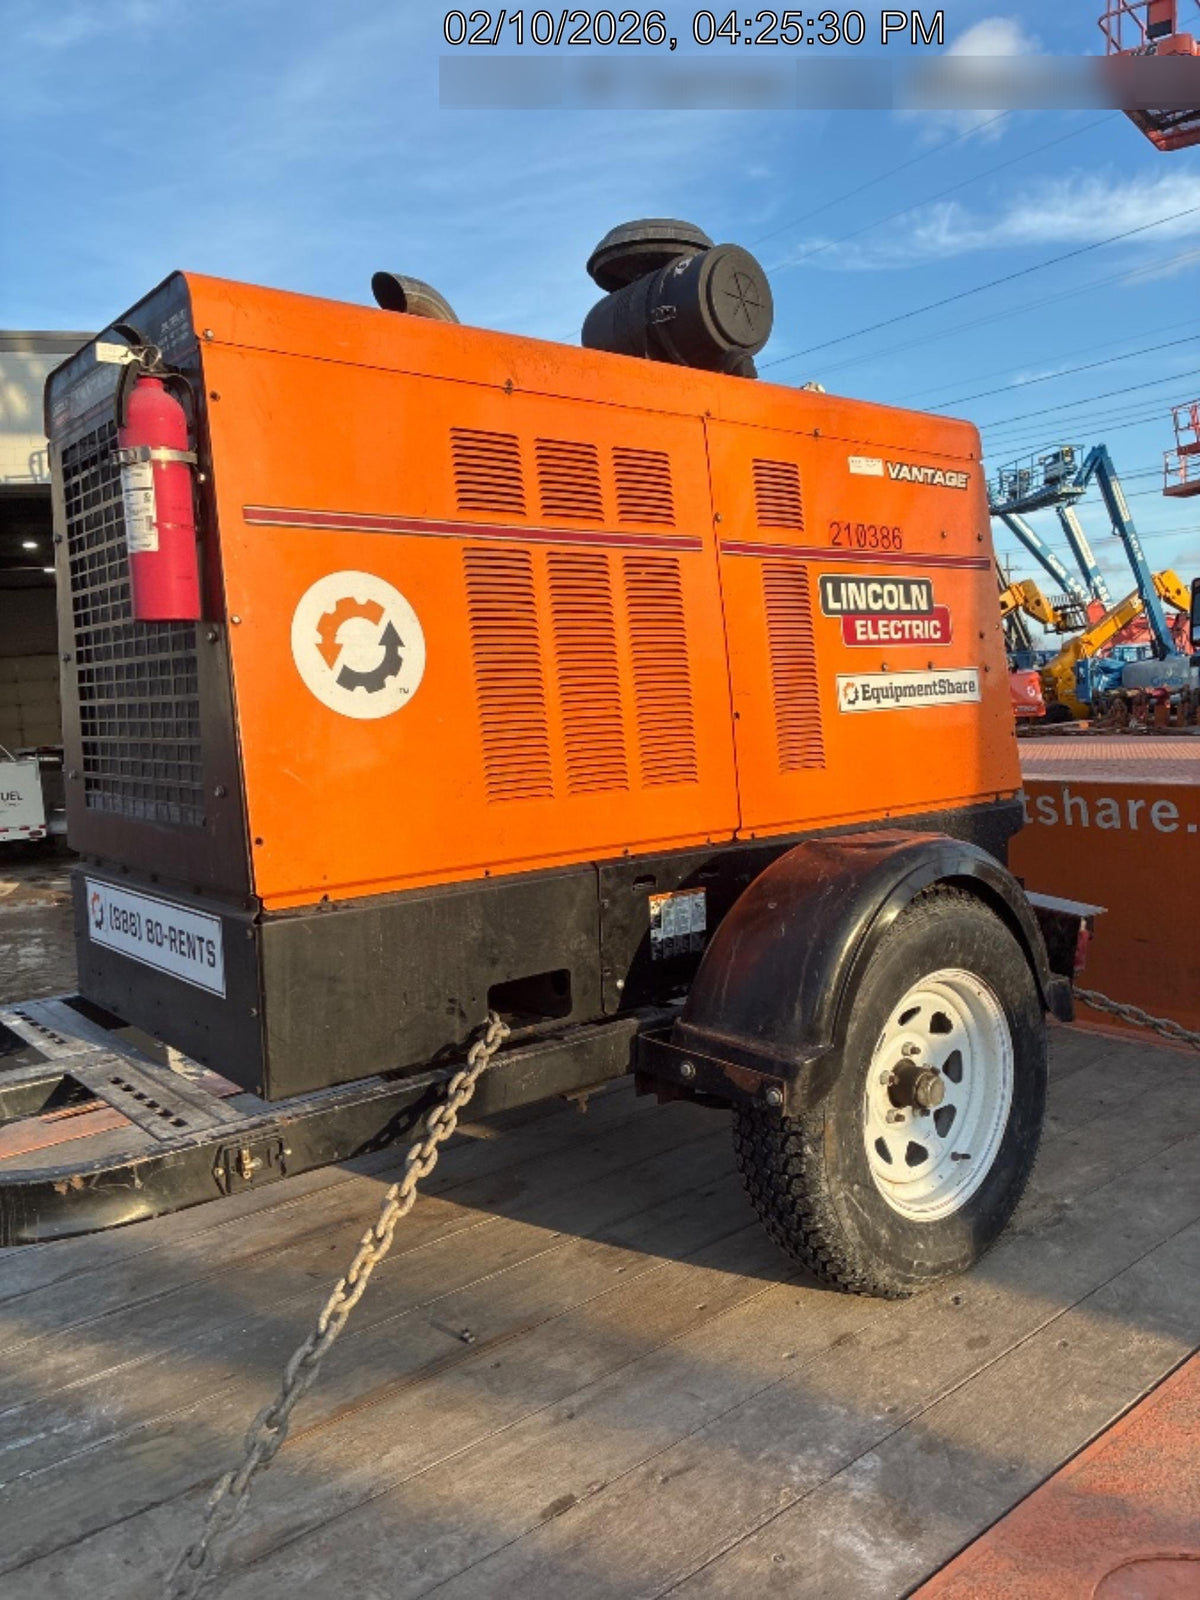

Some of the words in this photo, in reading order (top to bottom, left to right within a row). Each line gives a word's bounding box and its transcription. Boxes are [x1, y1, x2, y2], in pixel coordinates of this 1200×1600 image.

[886, 461, 969, 490] VANTAGE
[830, 521, 902, 550] 210386
[826, 582, 929, 611] LINCOLN
[854, 619, 942, 641] ELECTRIC
[860, 678, 976, 704] EquipmentShare
[109, 902, 143, 941] (888)
[145, 918, 216, 968] 80-RENTS
